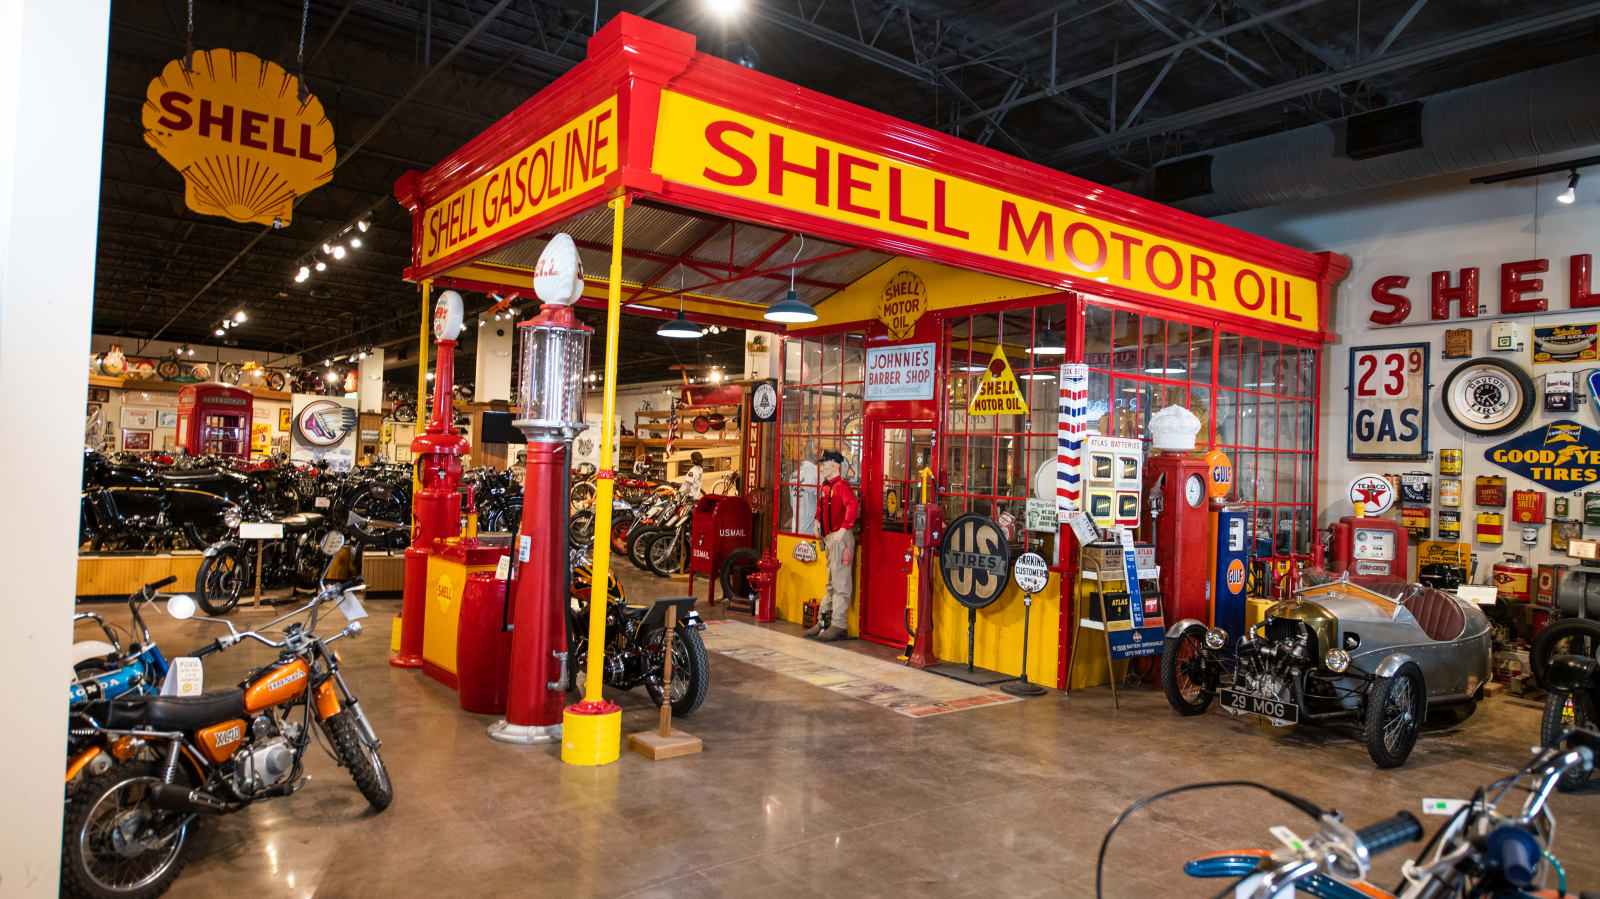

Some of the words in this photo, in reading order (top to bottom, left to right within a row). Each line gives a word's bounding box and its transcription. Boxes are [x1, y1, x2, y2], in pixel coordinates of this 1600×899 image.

[158, 91, 322, 163] SHELL
[428, 188, 478, 257] SHELL
[482, 109, 612, 228] GASOLINE
[702, 120, 970, 240] SHELL
[998, 200, 1217, 301] MOTOR
[1233, 268, 1302, 322] OIL
[885, 281, 919, 301] SHELL
[884, 299, 919, 316] MOTOR
[892, 319, 909, 329] OIL
[870, 347, 929, 370] JOHNNIE'S
[868, 371, 901, 385] BARBER
[906, 369, 930, 384] SHOP
[1469, 376, 1505, 390] Dayton
[980, 381, 1015, 395] SHELL
[974, 399, 1004, 411] MOTOR
[1006, 398, 1022, 410] OIL
[1471, 400, 1507, 414] TIRES
[1355, 408, 1420, 442] GAS
[1091, 439, 1109, 448] ATLAS
[1110, 440, 1140, 450] BATTERIES
[1213, 466, 1231, 483] GULF
[1530, 467, 1598, 482] TIRES
[1517, 493, 1537, 501] SILVER
[1517, 500, 1535, 508] SHELL
[1082, 517, 1095, 537] ATLAS
[950, 521, 999, 599] US
[953, 553, 997, 569] TIRES
[1018, 556, 1045, 568] PARKING
[1015, 567, 1048, 578] CUSTOMERS
[1228, 569, 1245, 585] GULF
[437, 585, 452, 600] SHELL
[1020, 582, 1041, 590] PLEASE
[1111, 598, 1129, 606] ATLAS
[268, 671, 306, 691] HONDA
[1231, 693, 1246, 709] 29
[1253, 700, 1285, 716] MOG
[215, 726, 240, 747] XL70
